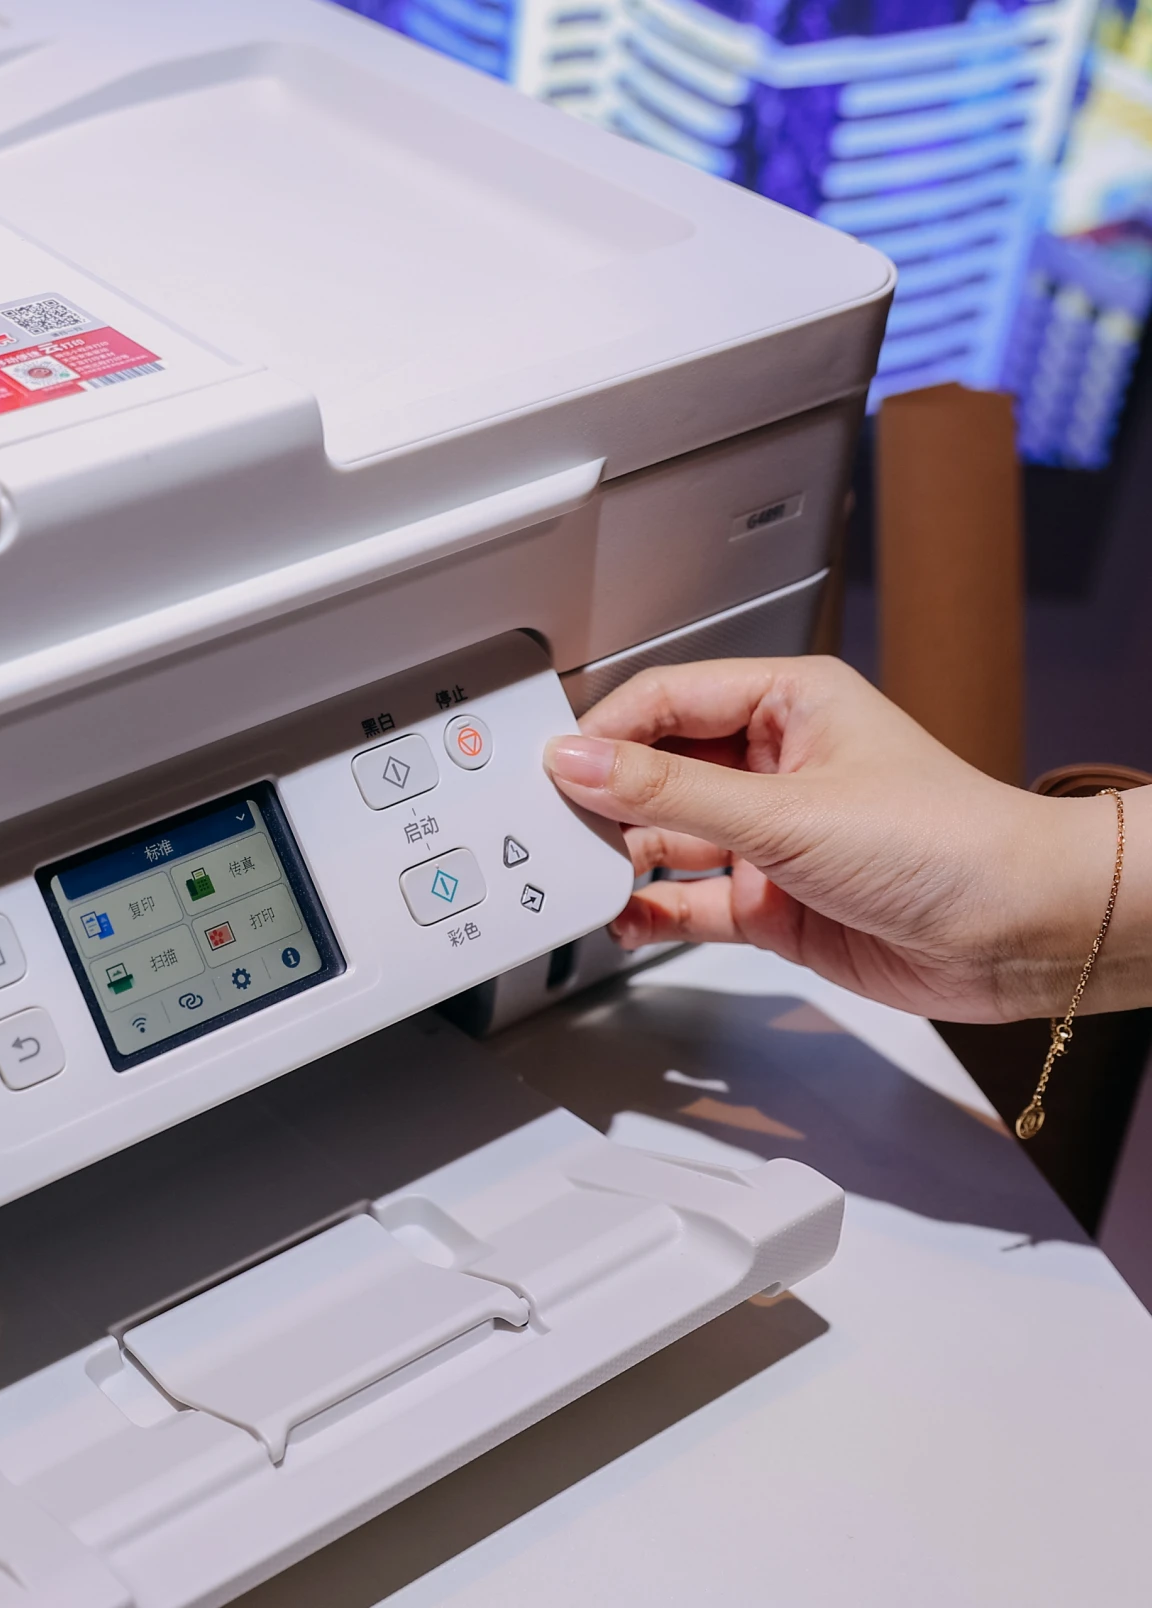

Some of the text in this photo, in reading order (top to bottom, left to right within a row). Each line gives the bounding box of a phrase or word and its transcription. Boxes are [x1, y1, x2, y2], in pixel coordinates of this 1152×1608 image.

[435, 684, 468, 709] 停止
[361, 713, 396, 738] 黑白
[403, 815, 440, 844] 启动
[144, 839, 174, 863] 标准
[228, 856, 256, 878] 传真
[128, 895, 155, 920] 复印
[249, 907, 276, 930] 打印
[447, 921, 482, 948] 彩色
[150, 948, 178, 973] 扫描
